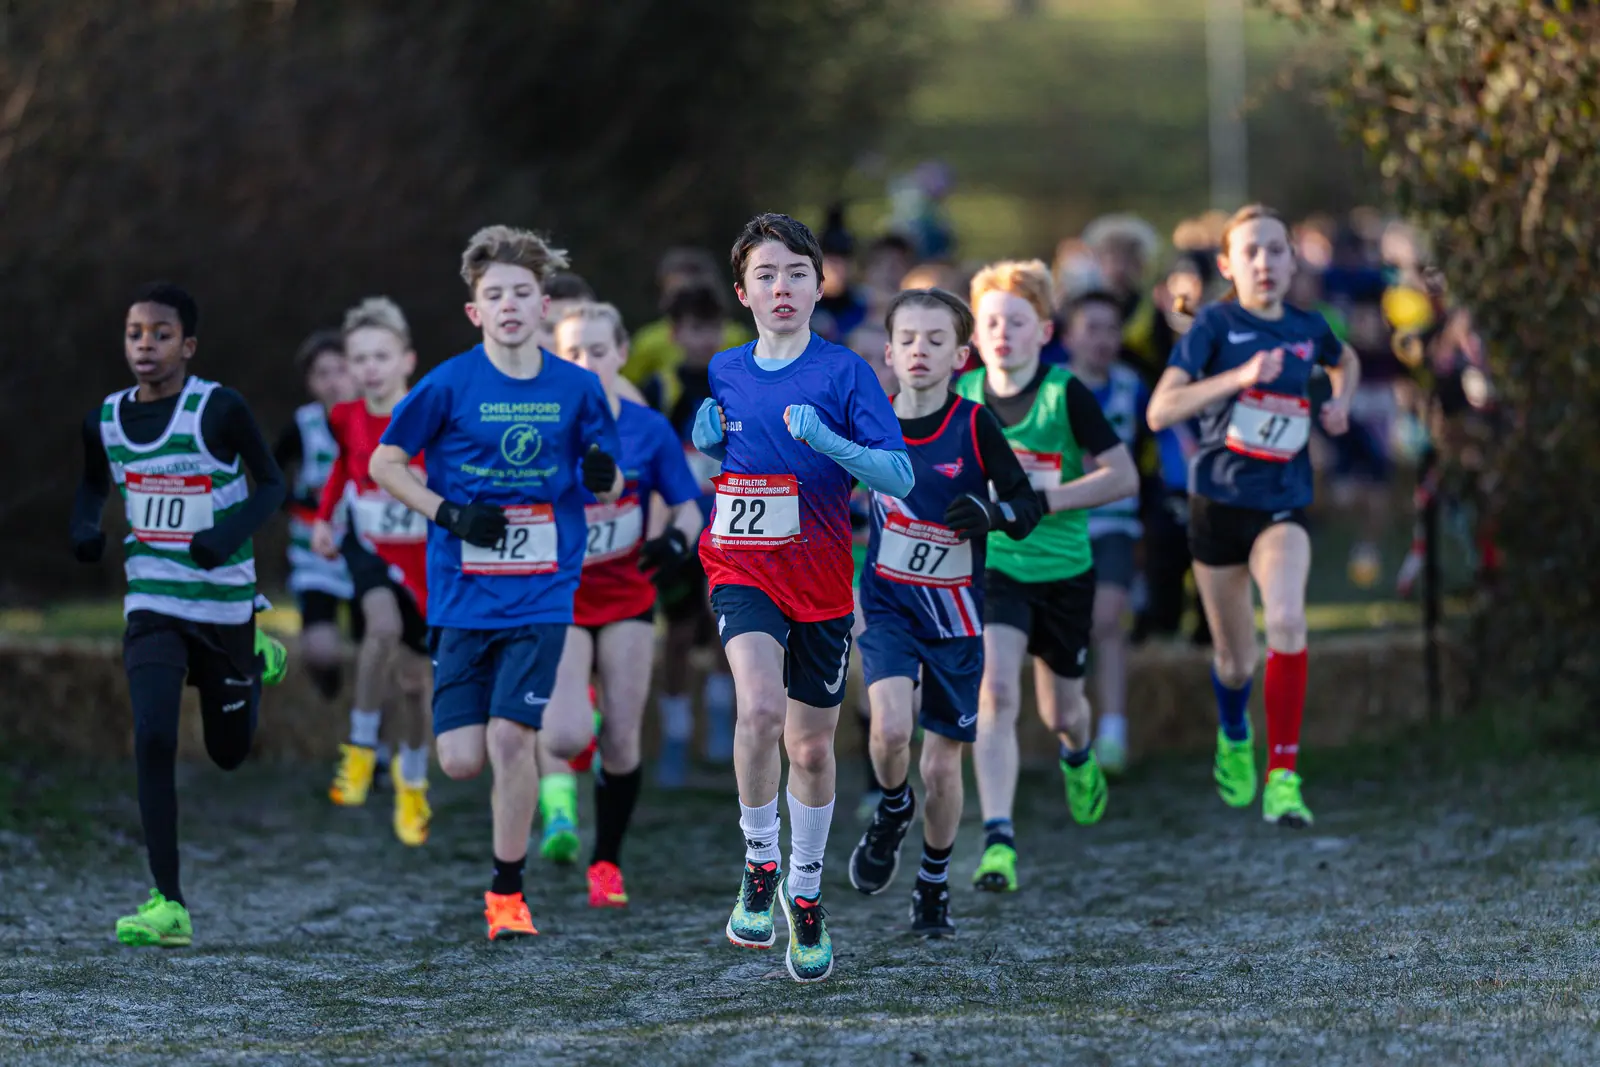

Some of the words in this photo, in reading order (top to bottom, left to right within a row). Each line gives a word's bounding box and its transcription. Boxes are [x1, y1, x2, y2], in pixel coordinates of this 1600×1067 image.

[479, 402, 561, 414] CHELMSFORD
[1258, 415, 1291, 447] 47
[739, 478, 767, 487] ATHLETICS
[744, 486, 791, 495] CHAMPIONSHIPS
[144, 496, 185, 529] 110
[729, 498, 766, 535] 22
[491, 527, 530, 560] 42
[588, 521, 618, 553] 27
[908, 542, 950, 575] 87
